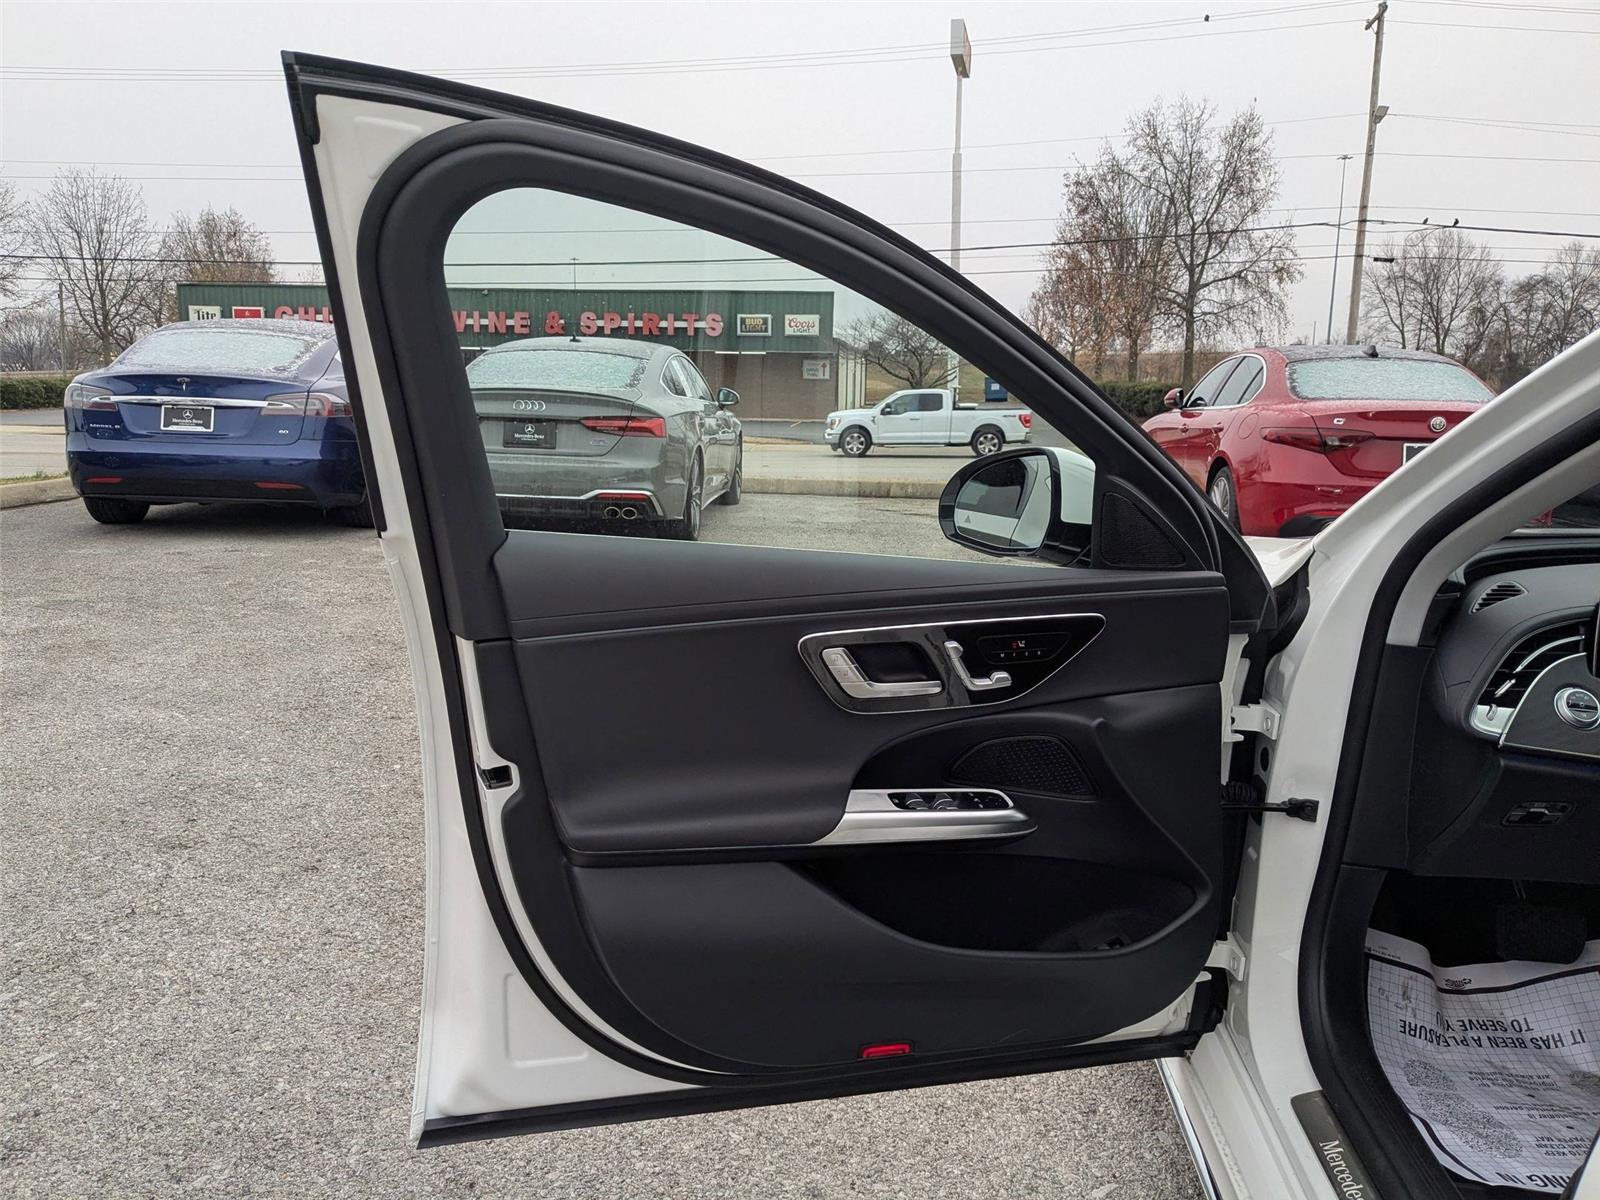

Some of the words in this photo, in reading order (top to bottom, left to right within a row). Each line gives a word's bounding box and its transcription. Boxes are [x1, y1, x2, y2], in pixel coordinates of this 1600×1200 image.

[545, 312, 565, 335] &
[580, 311, 722, 337] SPIRITS
[742, 324, 766, 332] LIGHT
[745, 317, 763, 325] BUD
[788, 317, 816, 329] Coors
[1436, 1011, 1455, 1032] YU
[1456, 1019, 1508, 1032] SERVE
[1510, 1017, 1534, 1033] TO
[1399, 1019, 1469, 1048] PLEASURE
[1569, 1029, 1586, 1046] IT
[1471, 1036, 1482, 1047] A
[1486, 1036, 1528, 1049] BEEN
[1530, 1033, 1565, 1050] HAS
[1319, 1140, 1364, 1200] Mercede
[1526, 1175, 1571, 1189] ING
